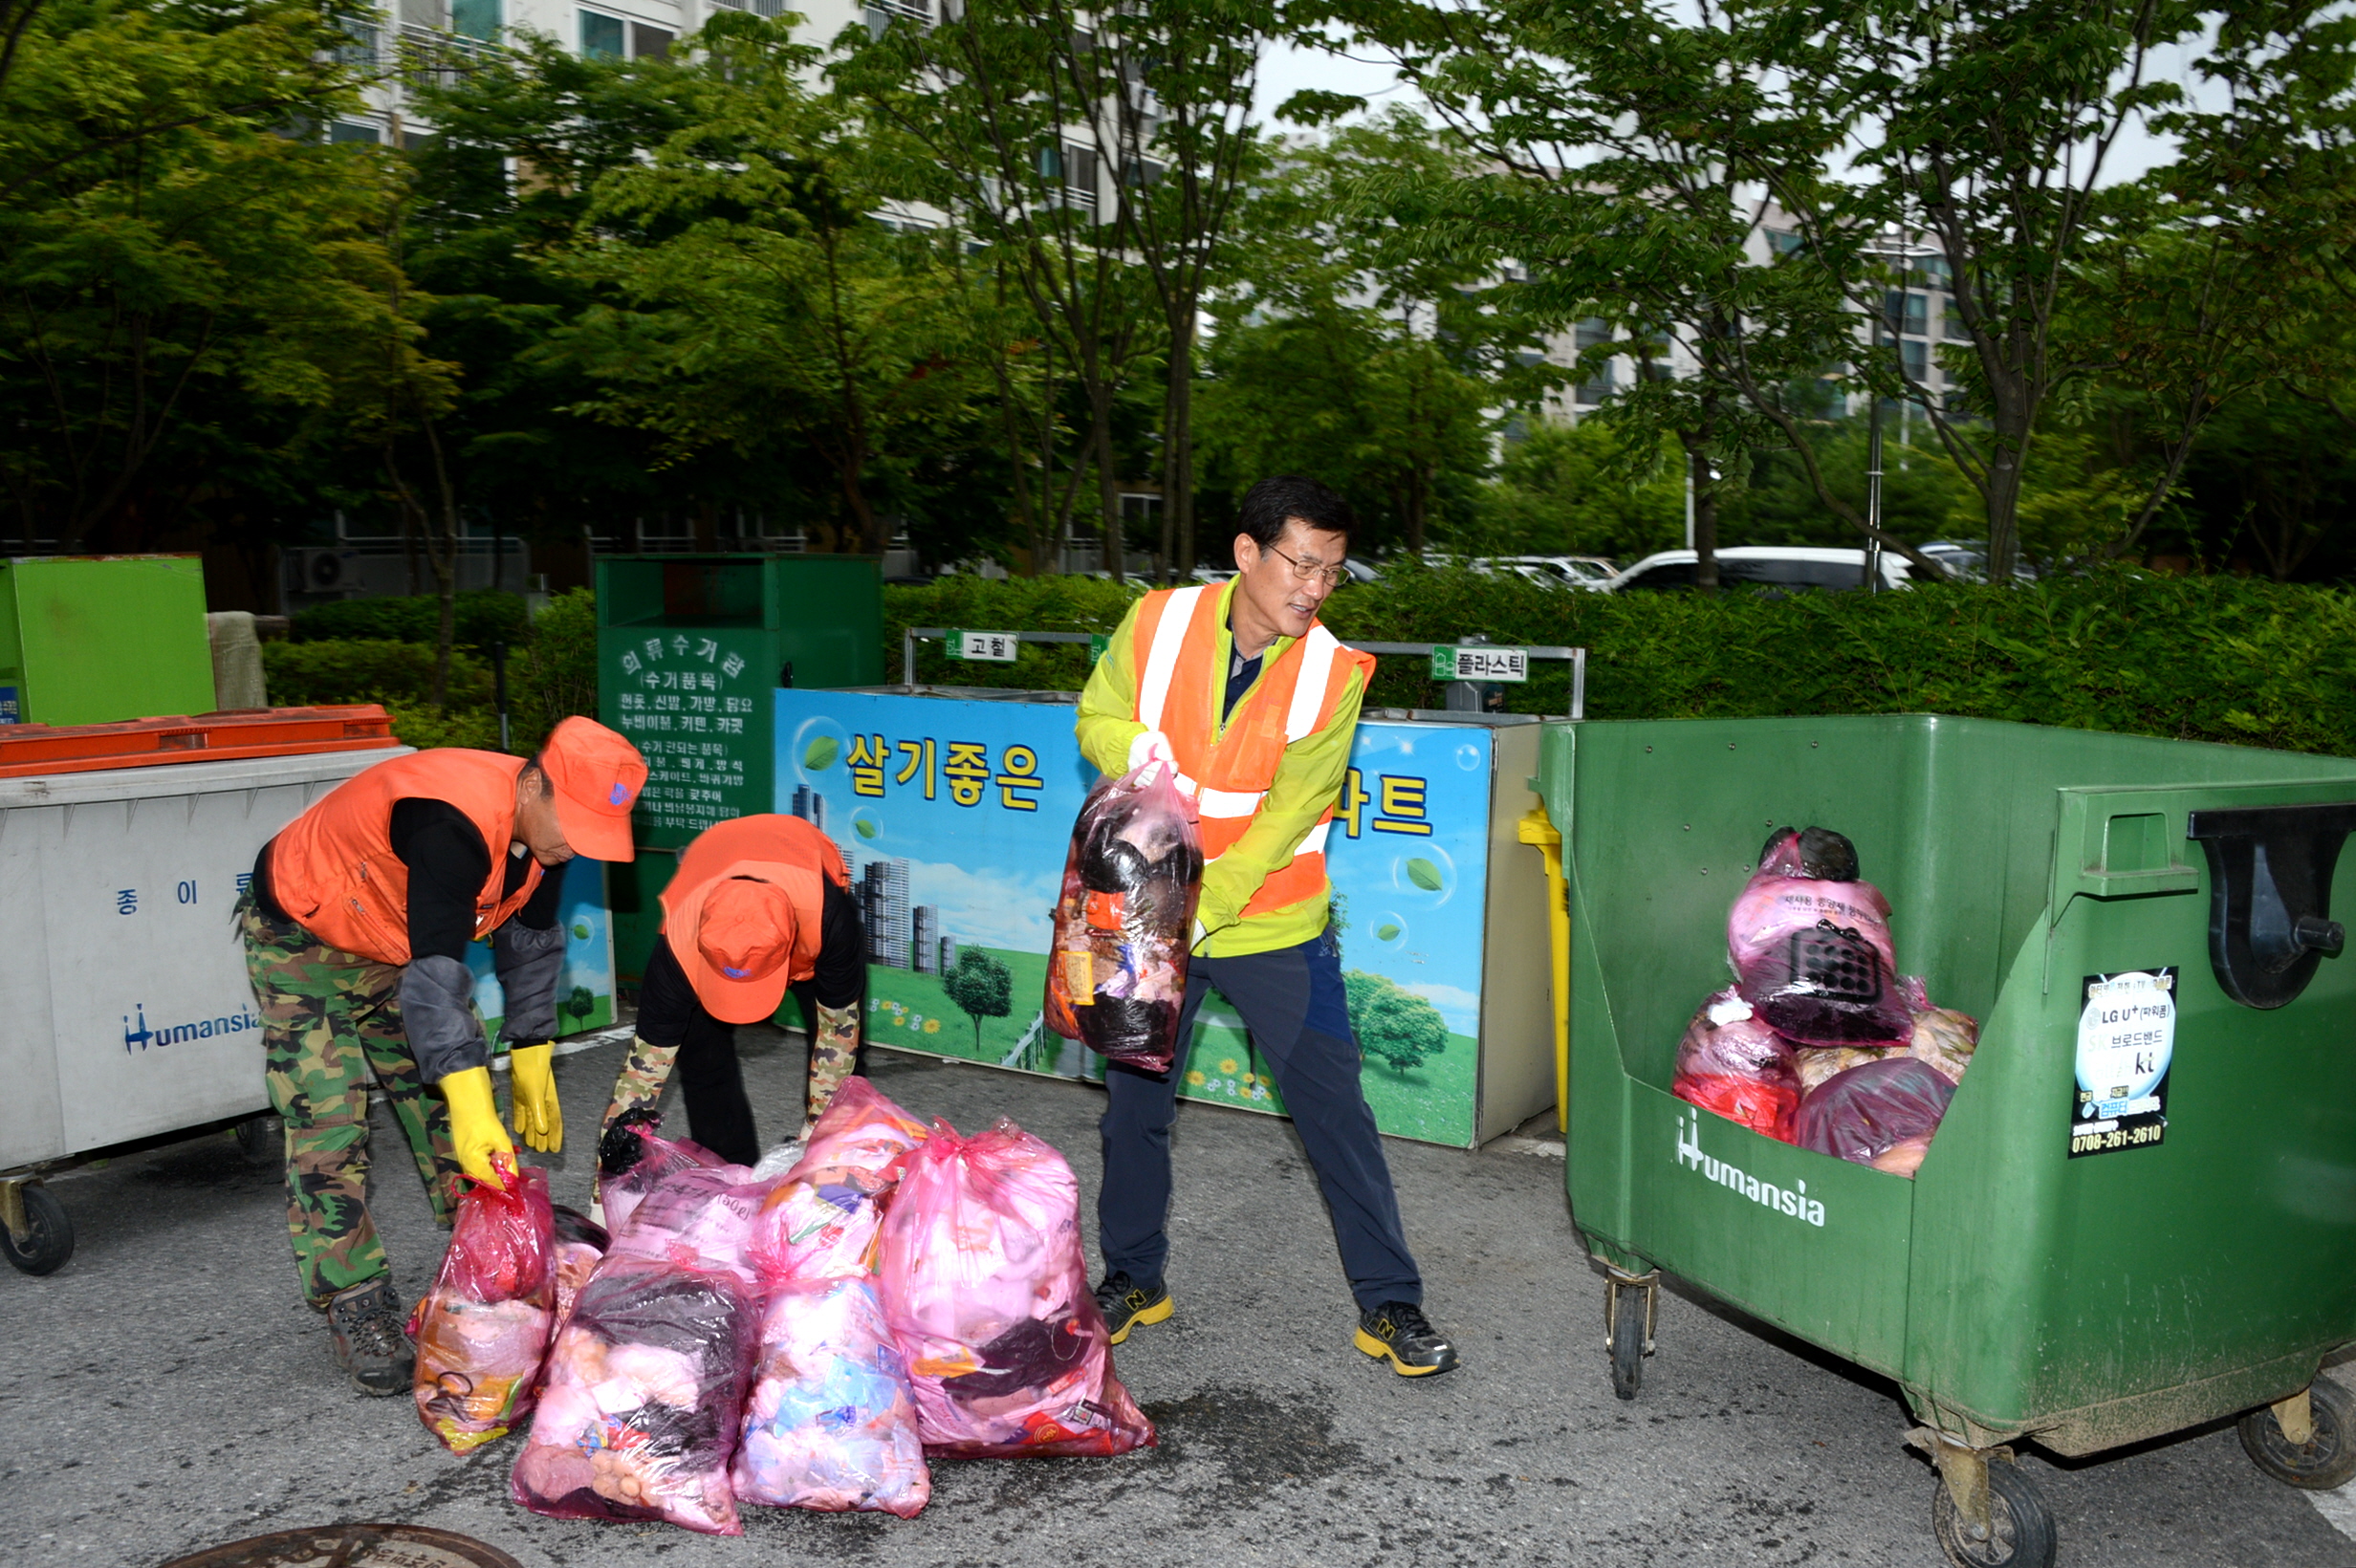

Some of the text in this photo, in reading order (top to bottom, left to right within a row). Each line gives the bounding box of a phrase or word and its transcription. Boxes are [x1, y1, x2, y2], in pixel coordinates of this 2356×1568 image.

[971, 638, 1005, 657] 고철
[1457, 653, 1525, 677] 플라스틱
[639, 671, 724, 691] (수거품목)
[845, 733, 1044, 813] 살기좋은
[2102, 1010, 2119, 1024] LG
[2110, 1030, 2163, 1049] 브로드밴드
[2072, 1124, 2161, 1153] 0708-261-2610
[1675, 1106, 1825, 1227] Humansia
